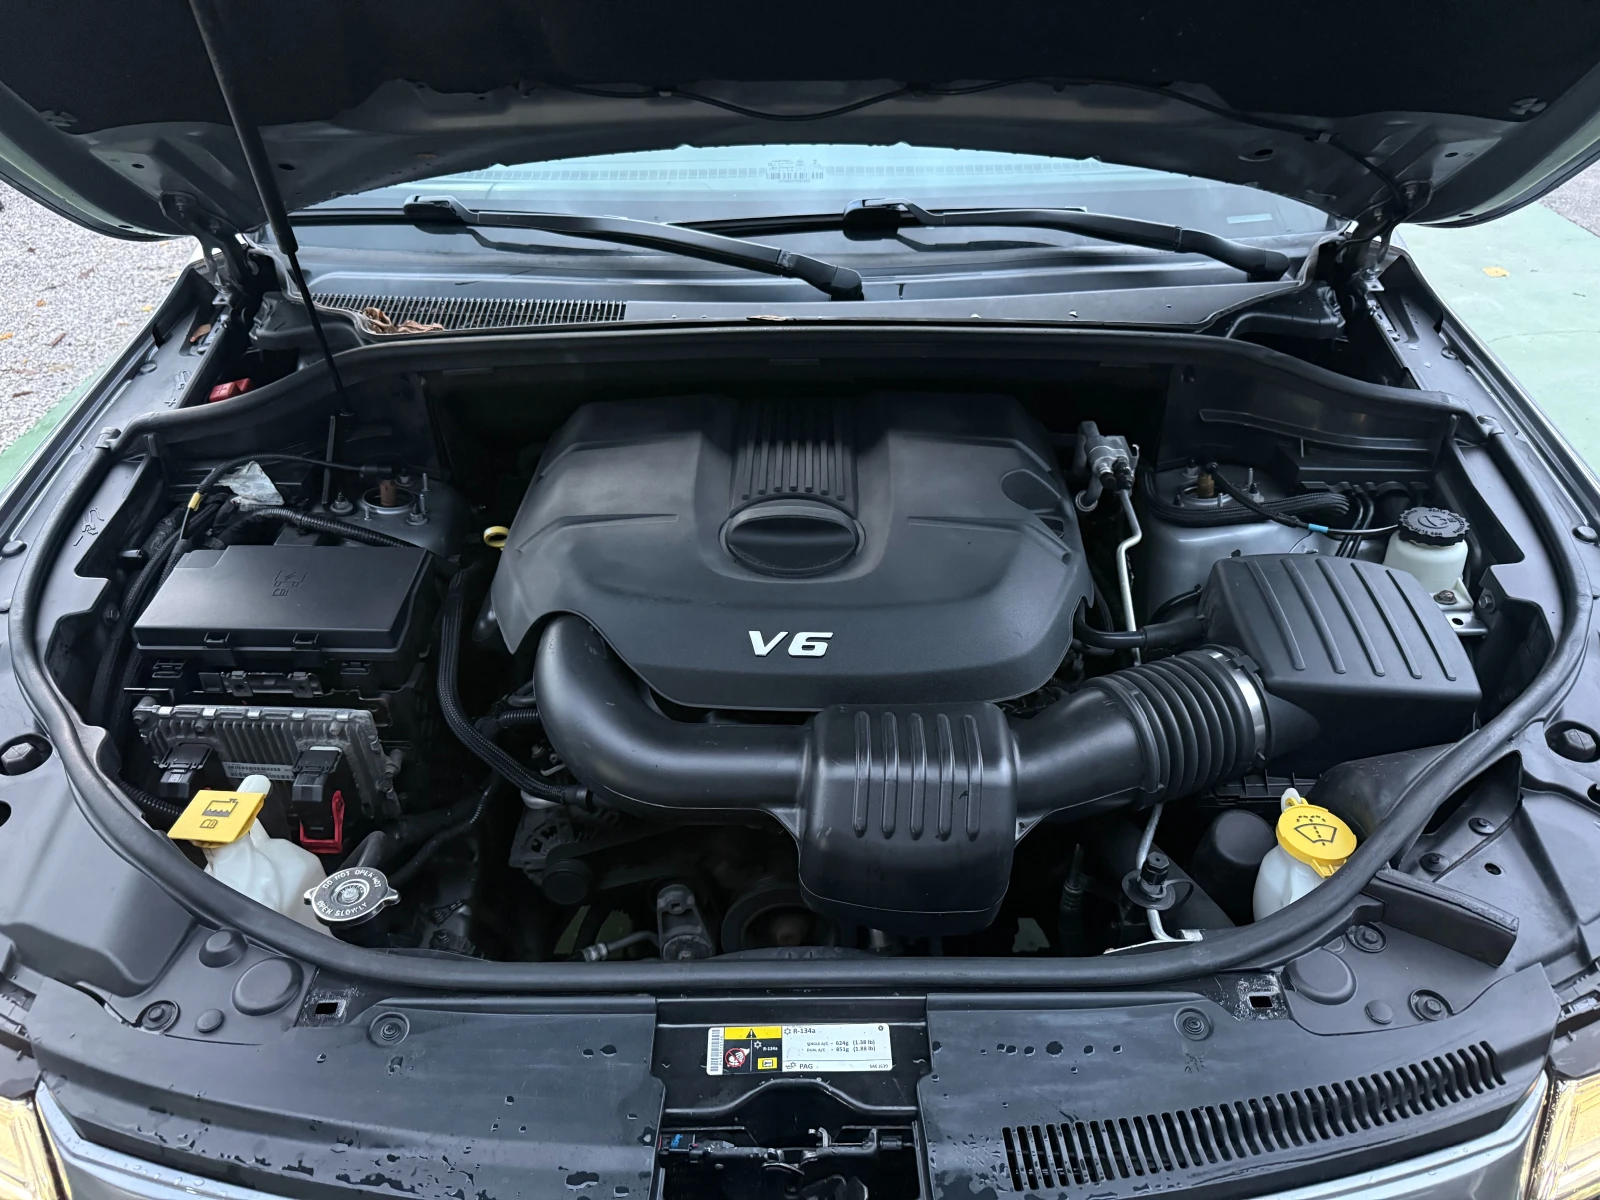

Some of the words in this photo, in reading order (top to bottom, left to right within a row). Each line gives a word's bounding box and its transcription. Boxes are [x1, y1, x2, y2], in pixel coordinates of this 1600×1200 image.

[748, 630, 834, 657] V6
[322, 880, 333, 889] DO
[334, 871, 350, 880] NOT
[354, 869, 374, 878] OPEN
[317, 900, 333, 915] OPEN
[335, 902, 367, 917] SLOWLY
